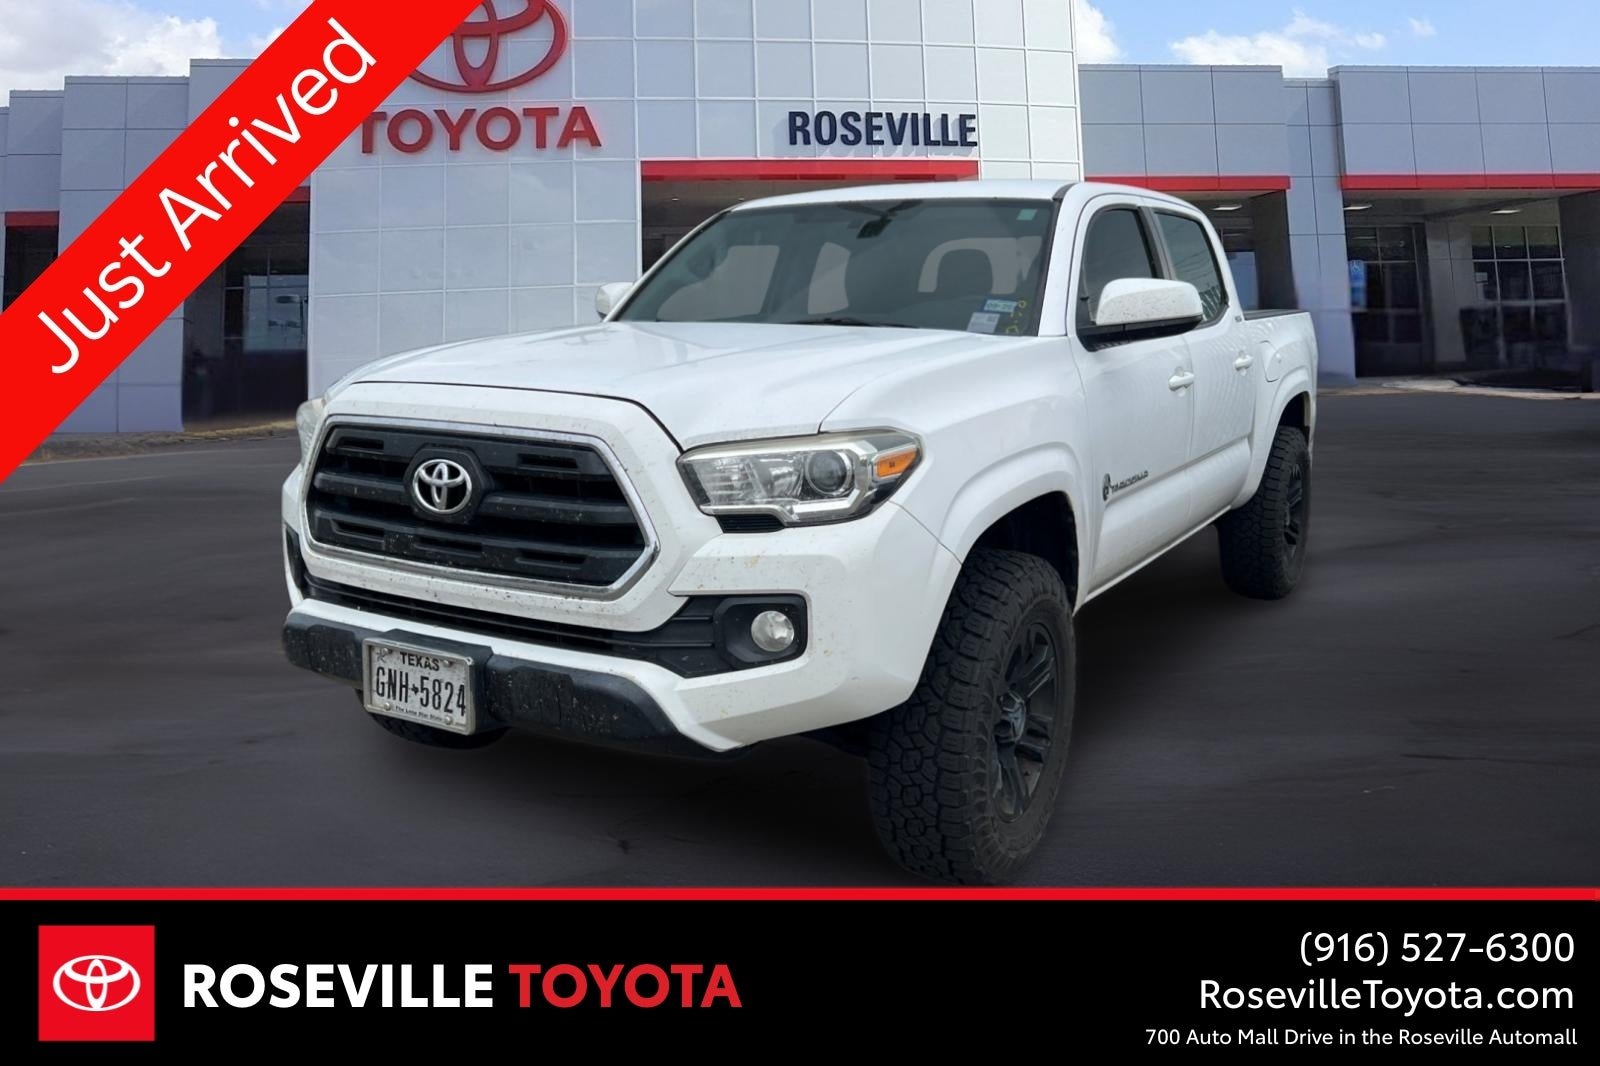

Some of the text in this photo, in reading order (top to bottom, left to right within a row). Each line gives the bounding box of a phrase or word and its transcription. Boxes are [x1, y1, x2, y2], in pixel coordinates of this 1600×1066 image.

[359, 106, 602, 153] TOYOTA
[787, 111, 978, 148] ROSEVILLE
[400, 651, 440, 671] TEXAS
[376, 666, 466, 717] GNH 5824
